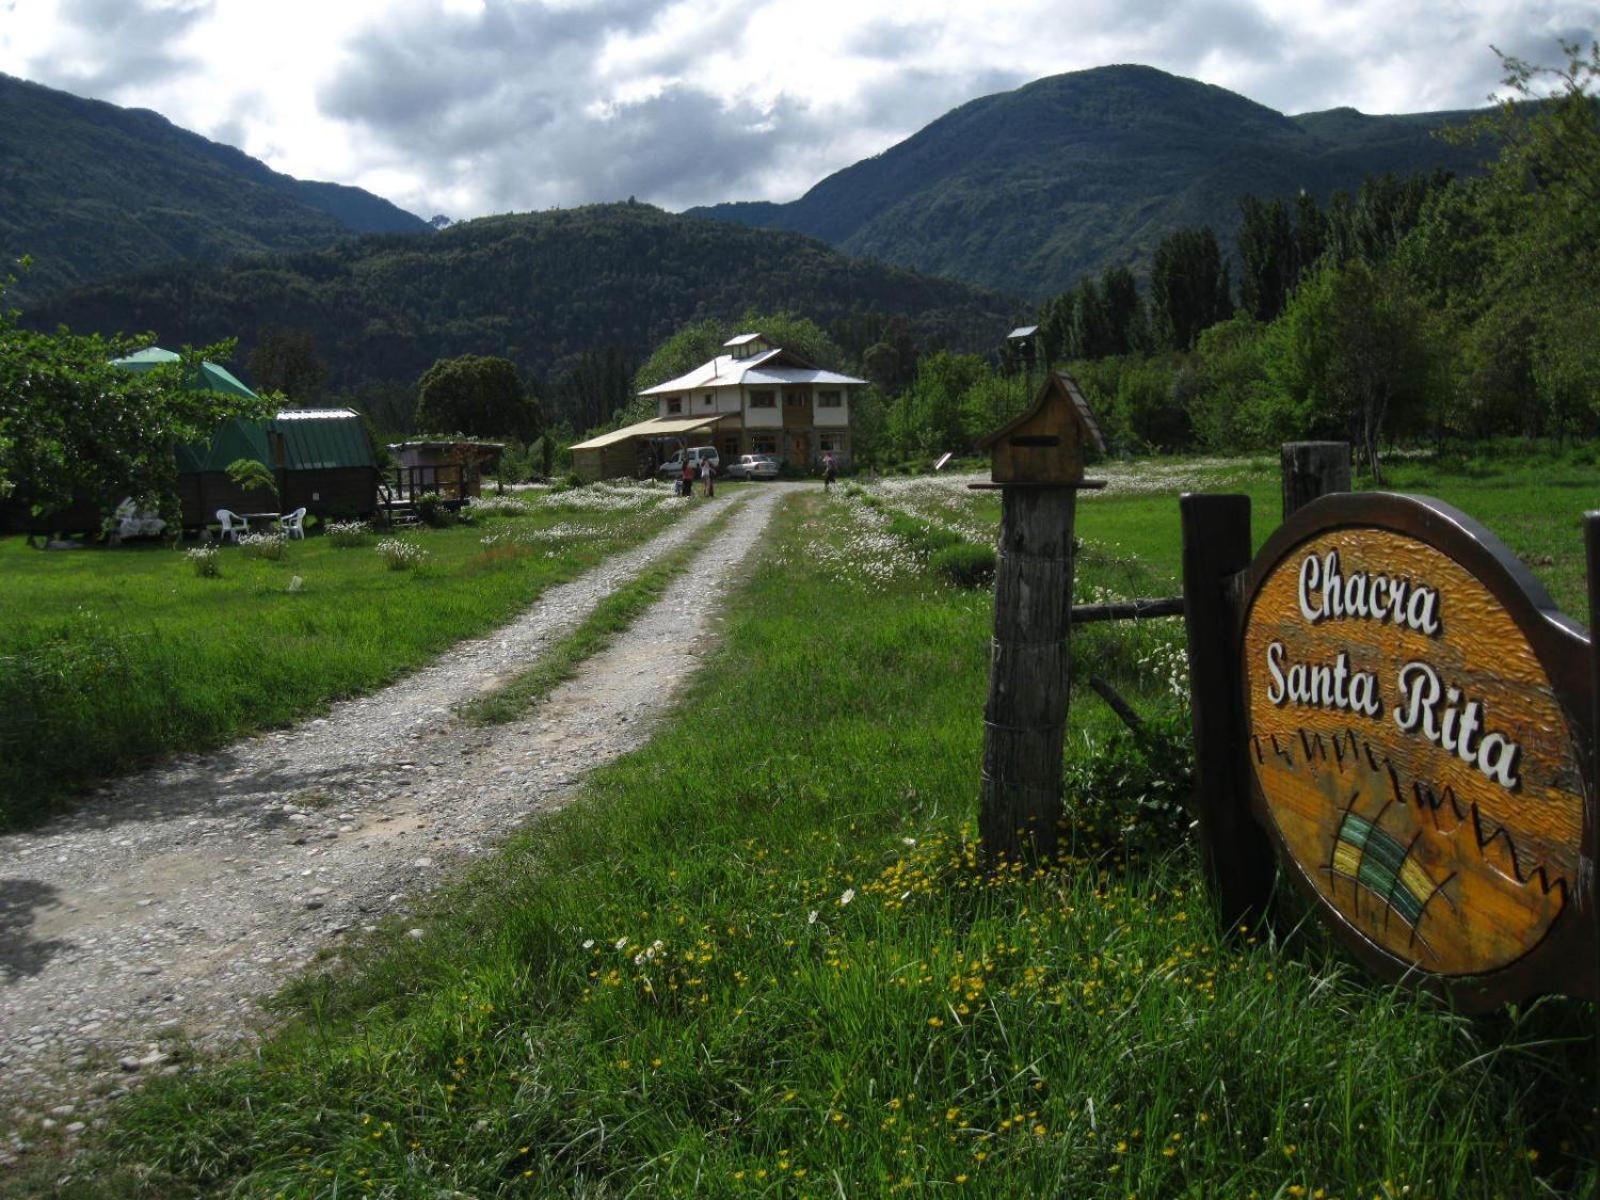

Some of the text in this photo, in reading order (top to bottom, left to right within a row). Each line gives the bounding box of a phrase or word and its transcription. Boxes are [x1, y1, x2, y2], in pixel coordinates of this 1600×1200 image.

[1298, 550, 1440, 634] Chacra
[1266, 642, 1519, 789] Santa Rita
